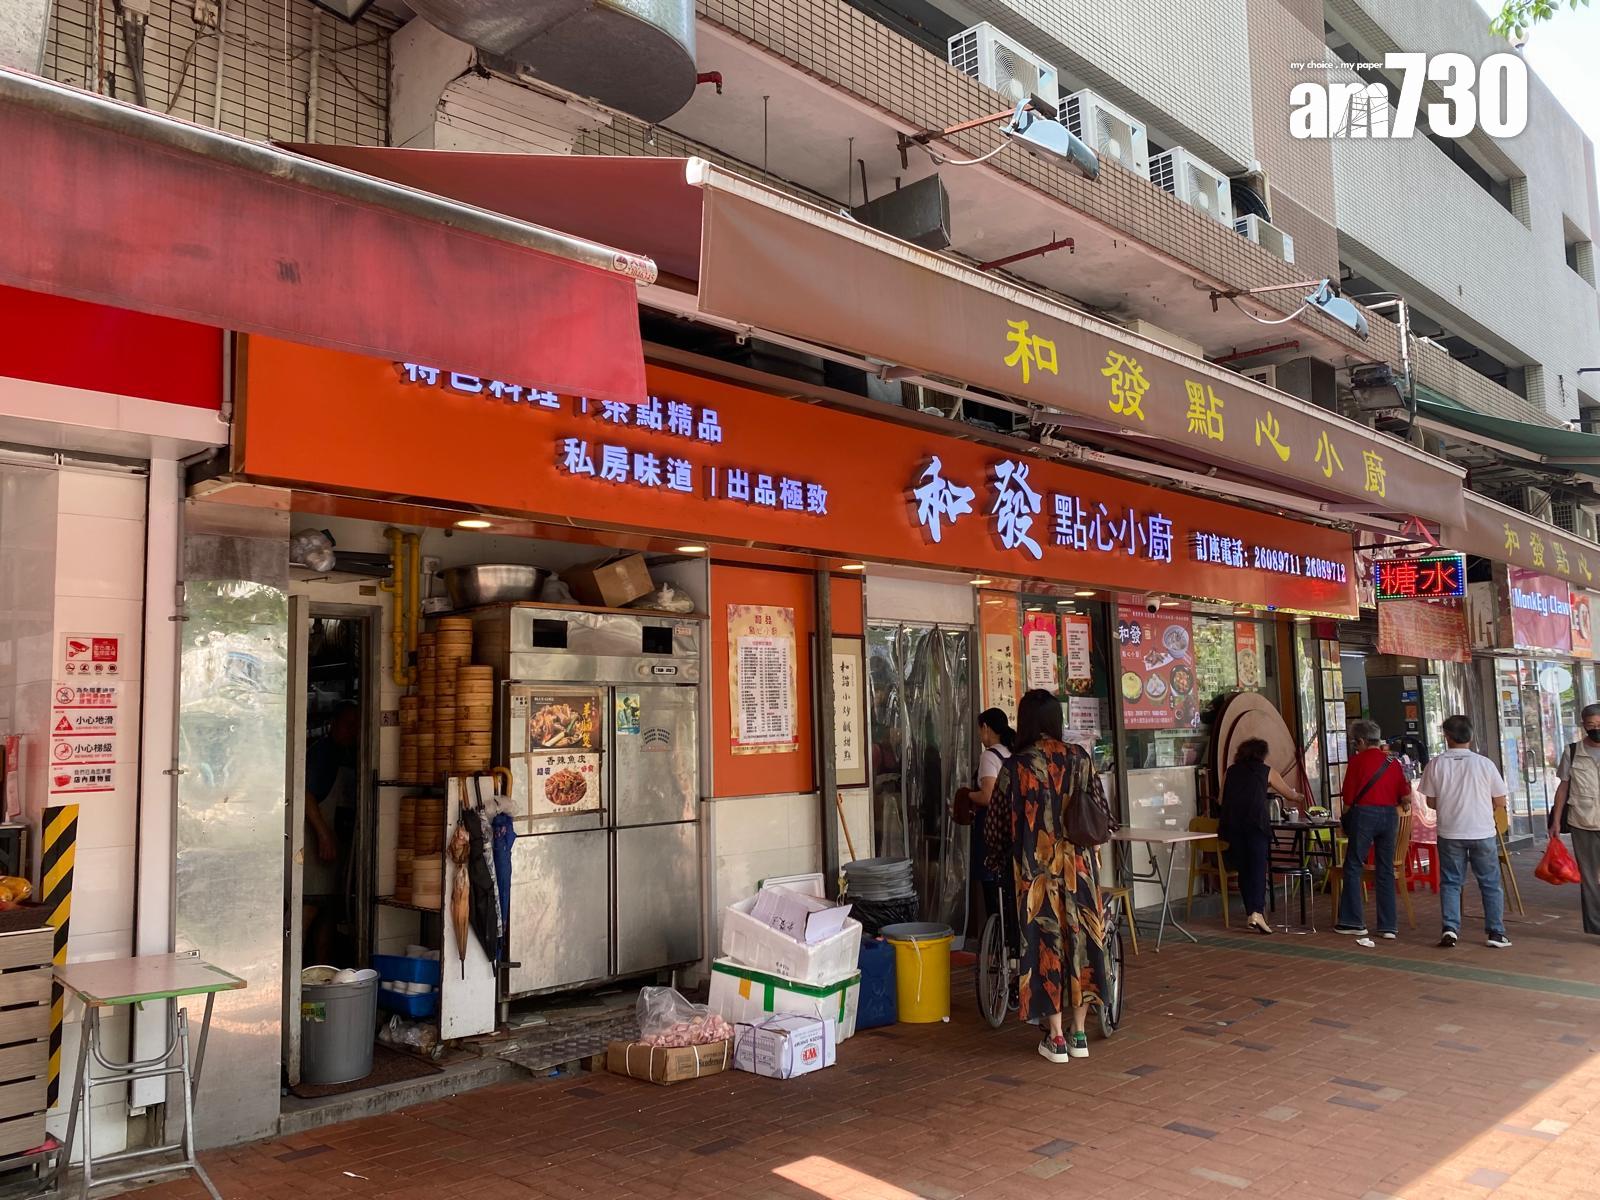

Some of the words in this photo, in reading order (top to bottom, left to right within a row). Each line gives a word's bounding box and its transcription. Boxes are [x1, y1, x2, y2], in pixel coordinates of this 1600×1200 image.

[601, 397, 722, 443] 茶點精品
[1003, 319, 1387, 498] 和發點心小廚
[562, 437, 693, 492] 私房味道
[727, 468, 828, 515] 出品極致
[912, 455, 1043, 560] 和發
[1054, 494, 1173, 564] 點心小廚
[1254, 546, 1302, 576] 26089711
[1304, 556, 1347, 584] 26089712
[1380, 560, 1457, 595] 糖水
[1118, 625, 1141, 643] 和發
[76, 715, 114, 725] 小心地滑
[74, 743, 112, 753] 小心梯級
[546, 755, 586, 765] 香辣魚皮
